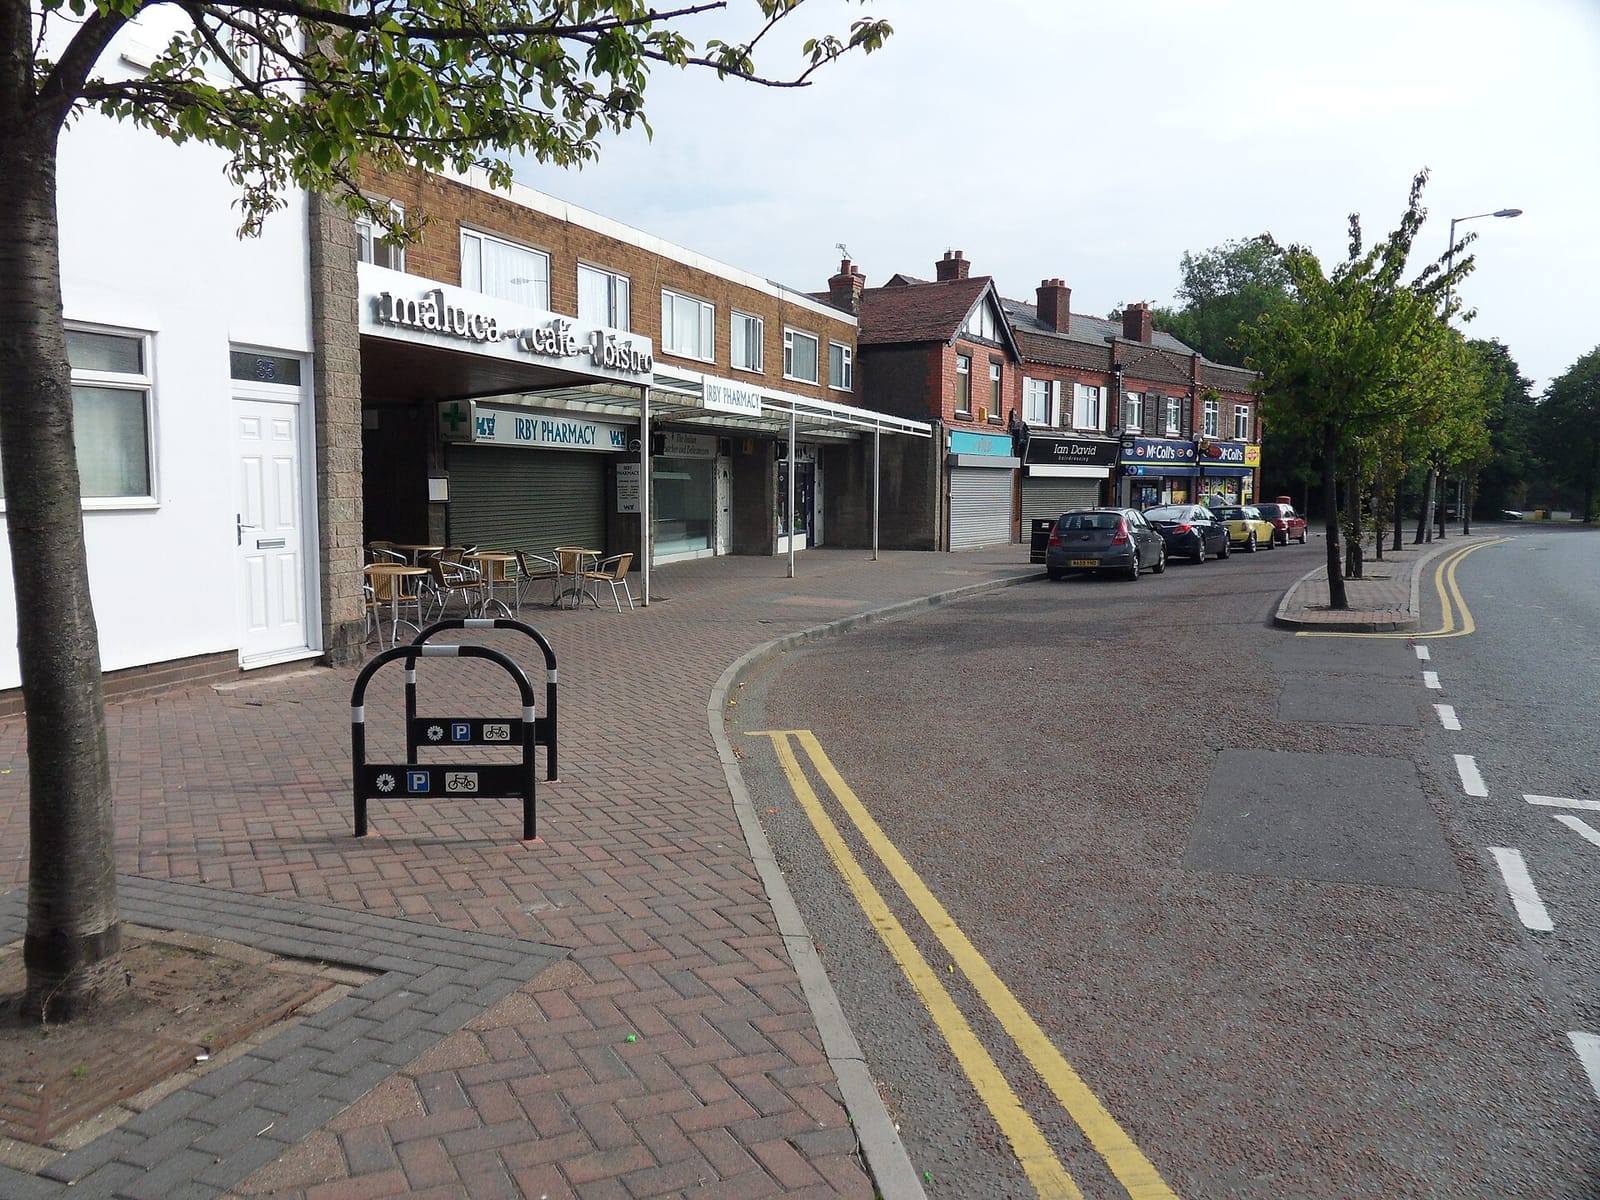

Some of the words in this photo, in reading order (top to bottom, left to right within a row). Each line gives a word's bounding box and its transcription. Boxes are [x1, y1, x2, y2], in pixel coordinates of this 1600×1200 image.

[378, 289, 500, 343] maluca
[599, 331, 653, 374] bistro
[706, 384, 721, 403] IRBY
[723, 387, 760, 409] PHARMACY
[515, 417, 538, 441] IRBY
[541, 421, 596, 446] PHARMACY
[1054, 443, 1068, 454] Ian
[1071, 444, 1096, 455] David
[1146, 445, 1175, 459] McColl's
[456, 726, 467, 739] P
[412, 774, 426, 790] P
